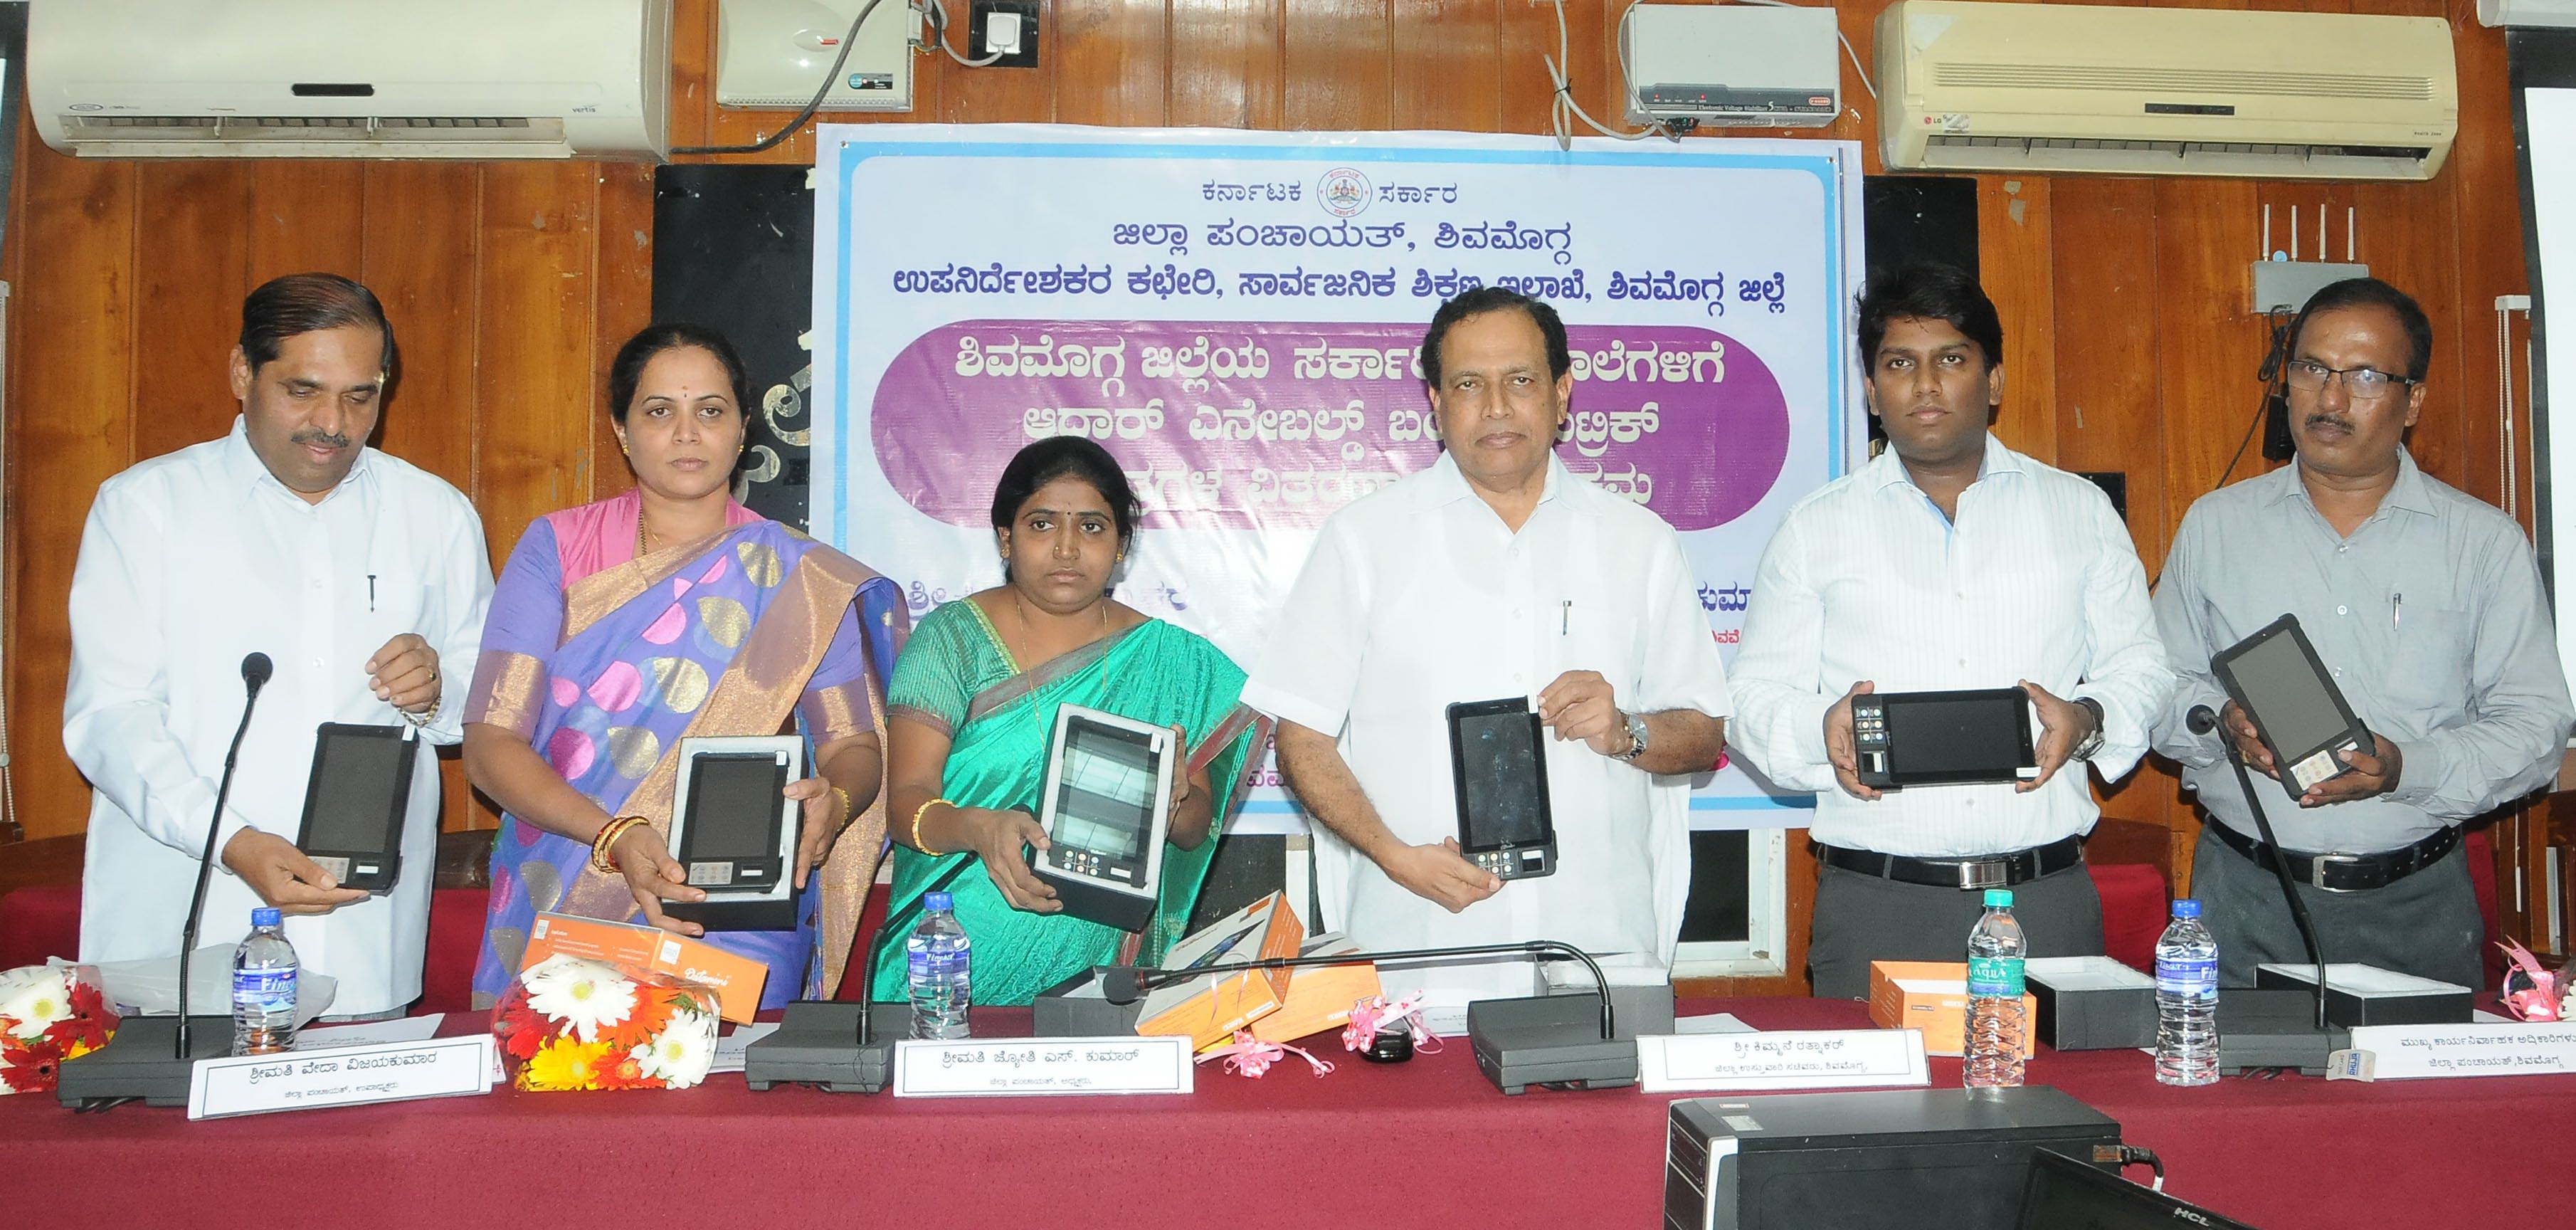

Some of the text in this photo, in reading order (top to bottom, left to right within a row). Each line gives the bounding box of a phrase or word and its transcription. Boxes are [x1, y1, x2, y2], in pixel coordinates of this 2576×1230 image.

[1203, 179, 1458, 204] ಕರ್ನಾಟಕ ಸರ್ಕಾರ
[1113, 219, 1572, 264] ಜಿಲ್ಲಾ ಪಂಚಾಯತ್, ಶಿವಮೊಗ್ಗ
[893, 262, 1112, 295] ಉಪನಿರ್ದೇಶಕರ
[1127, 263, 1223, 300] ಕಛೇರಿ,
[1239, 265, 1396, 296] ಸಾರ್ವಜನಿಕ
[1607, 271, 1724, 316] ಶಿವಮೊಗ್ಗ
[1738, 271, 1786, 315] ಜಿಲ್ಲೆ
[955, 335, 1125, 397] ಶಿವಮೊಗ್ಗ
[1141, 335, 1270, 393] ಜಿಲ್ಲೆಯ
[1734, 1039, 1844, 1058] ಶ್ರೀ ಕಿಮ್ಮನೆ ರತ್ನಾಕರ್
[2401, 1037, 2432, 1051] ಮುಖ್ಯ
[250, 1051, 438, 1085] ಶ್ರೀಮತಿ ವೇದಾ ವಿಜಯಕುಮಾರ
[942, 1050, 986, 1068] ಶ್ರೀಮತಿ
[993, 1049, 1036, 1068] ಜ್ಯೋತಿ
[1085, 1048, 1140, 1063] ಕುಮಾರ್
[2348, 1053, 2358, 1076] AHUJA
[2429, 1058, 2456, 1071] ಜಿಲ್ಲಾ
[2174, 1207, 2210, 1227] HCL
